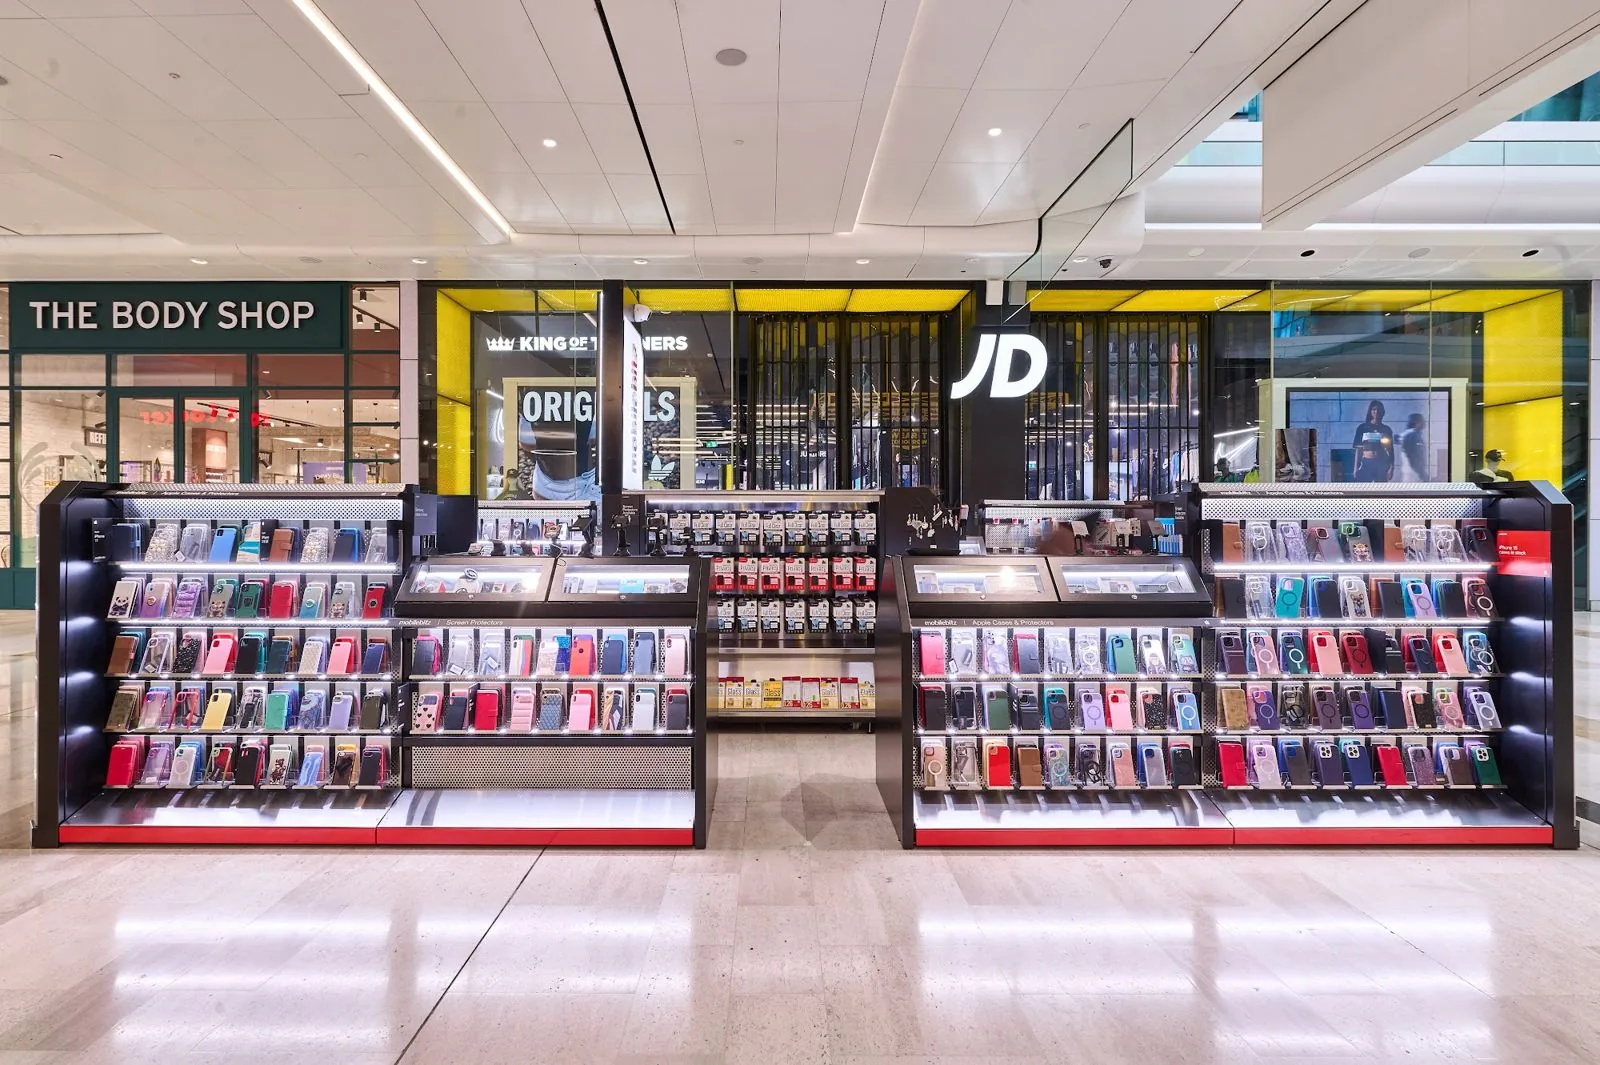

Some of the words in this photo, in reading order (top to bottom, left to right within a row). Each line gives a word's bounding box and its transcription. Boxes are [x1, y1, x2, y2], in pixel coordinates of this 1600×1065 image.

[29, 301, 99, 329] THE
[112, 301, 208, 330] BODY
[218, 301, 315, 330] SHOP
[520, 336, 567, 351] KING
[569, 337, 588, 347] OF
[950, 333, 1048, 400] JD
[523, 390, 676, 422] ORIGLS
